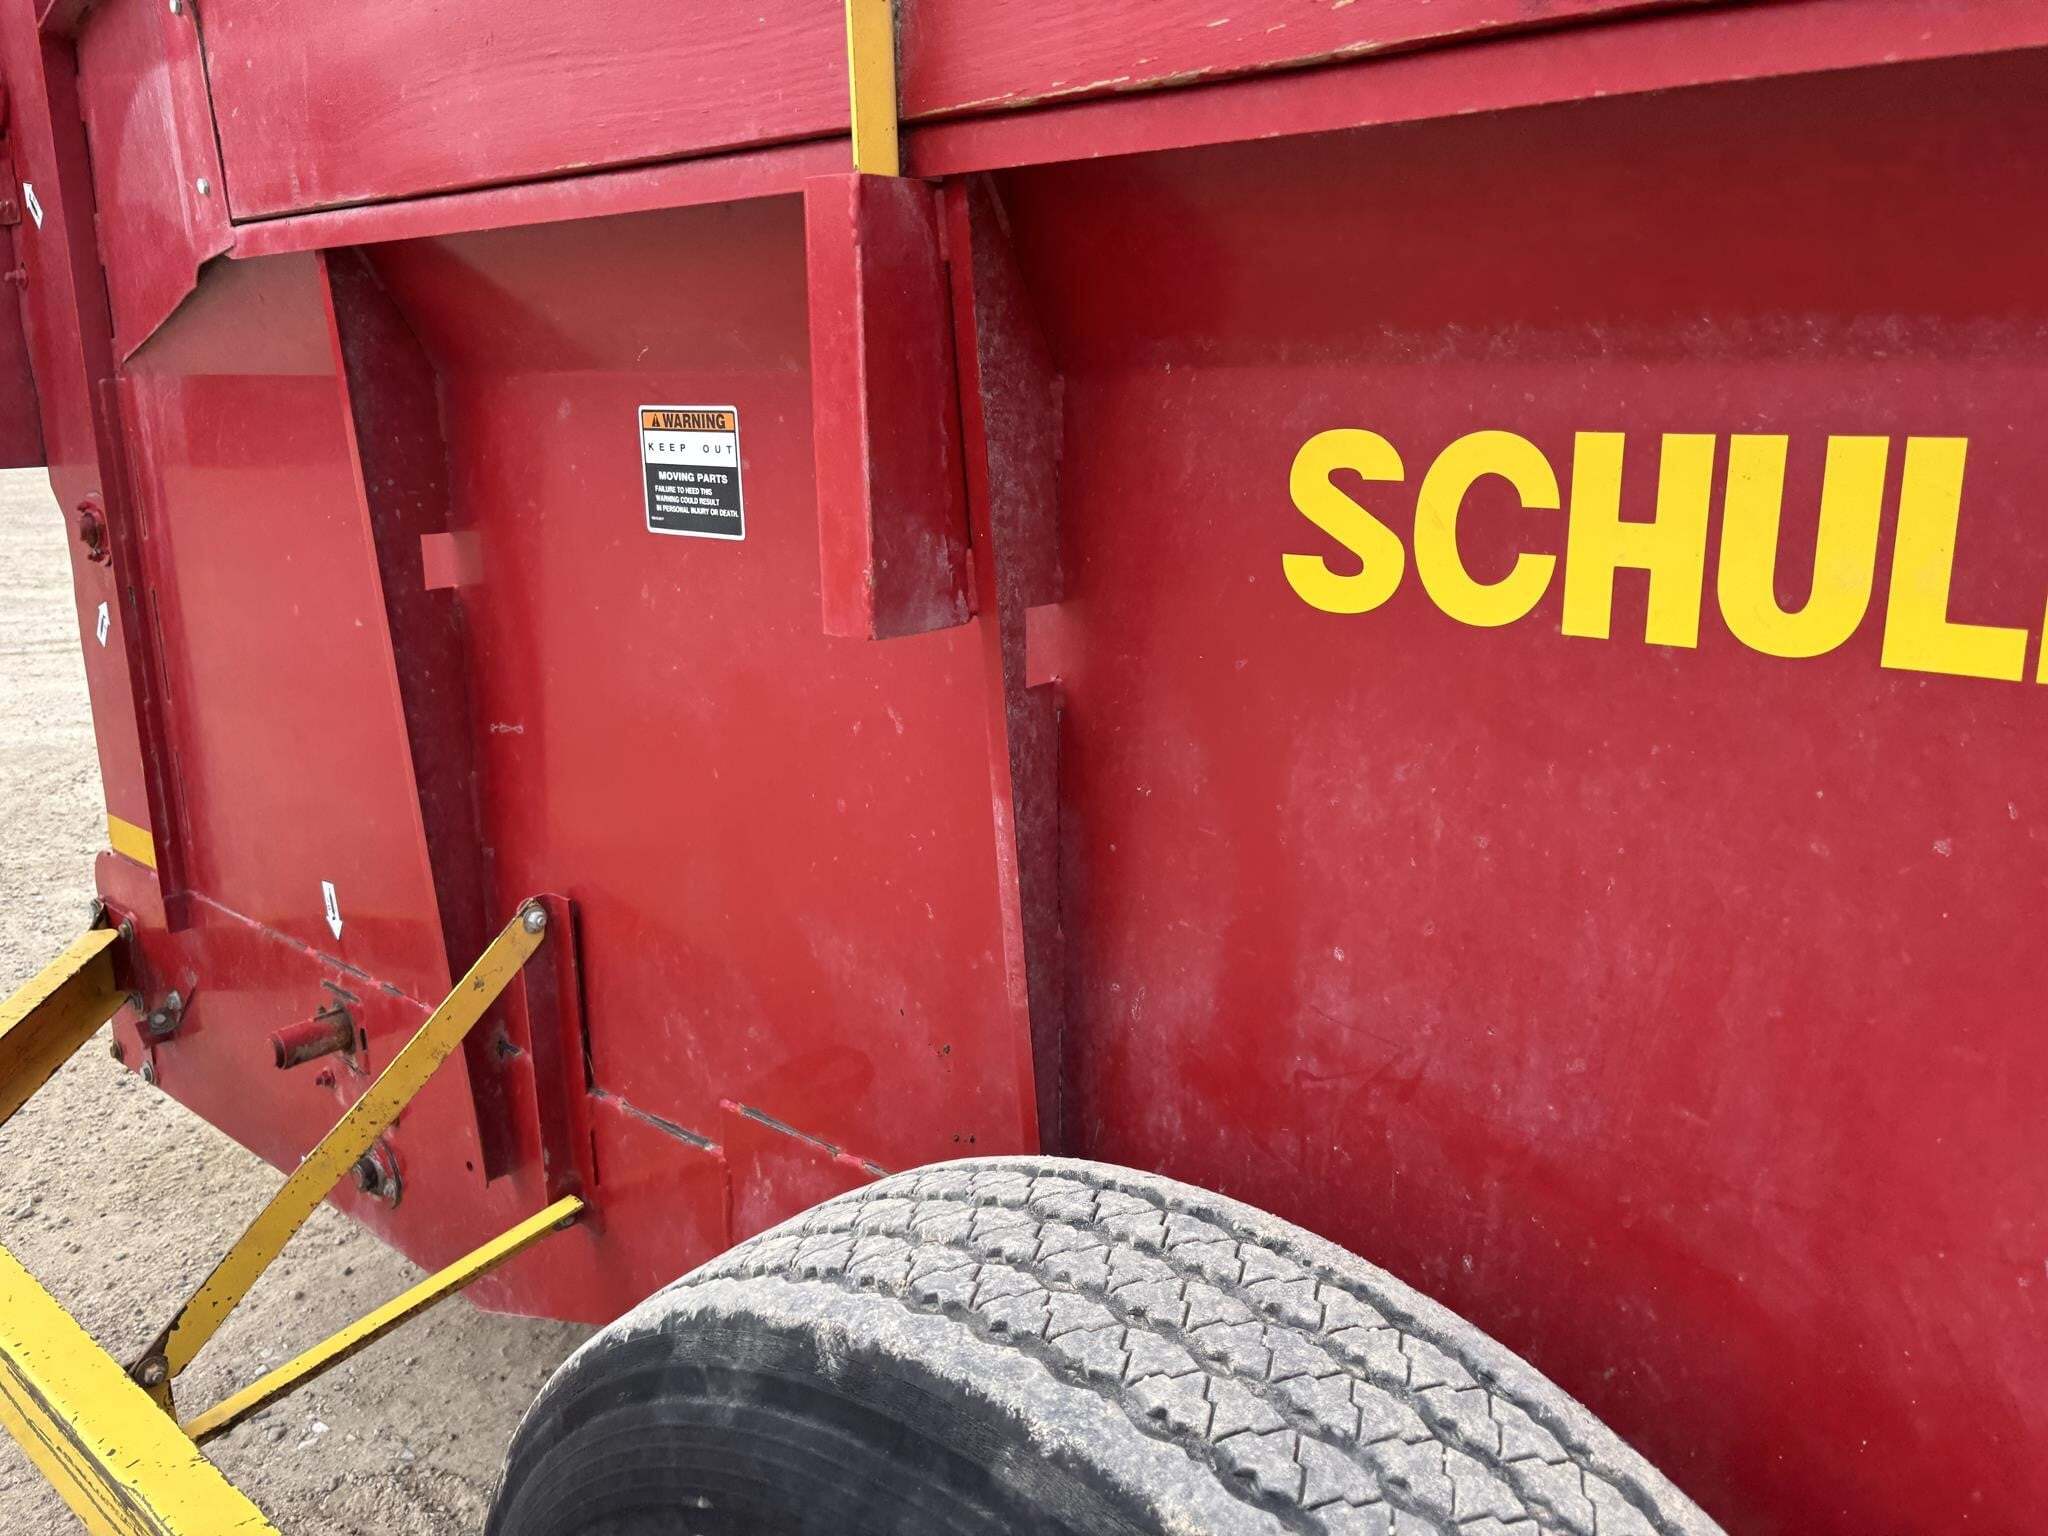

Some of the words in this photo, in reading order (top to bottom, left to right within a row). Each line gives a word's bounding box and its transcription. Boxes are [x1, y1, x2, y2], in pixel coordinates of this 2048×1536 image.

[663, 413, 726, 429] WARNING
[648, 442, 686, 452] KEEP
[702, 444, 733, 454] OUT
[658, 471, 695, 482] MOVING
[697, 473, 728, 484] PARTS
[654, 485, 677, 493] FAILURE
[677, 486, 685, 494] TO
[700, 488, 713, 496] THIS
[655, 495, 679, 504] WARNING
[680, 496, 699, 505] COULD
[699, 497, 720, 506] RESULT
[662, 505, 690, 514] PERSONAL
[690, 506, 709, 516] INJURY
[710, 508, 719, 517] OR
[1282, 428, 2048, 684] SCHUL
